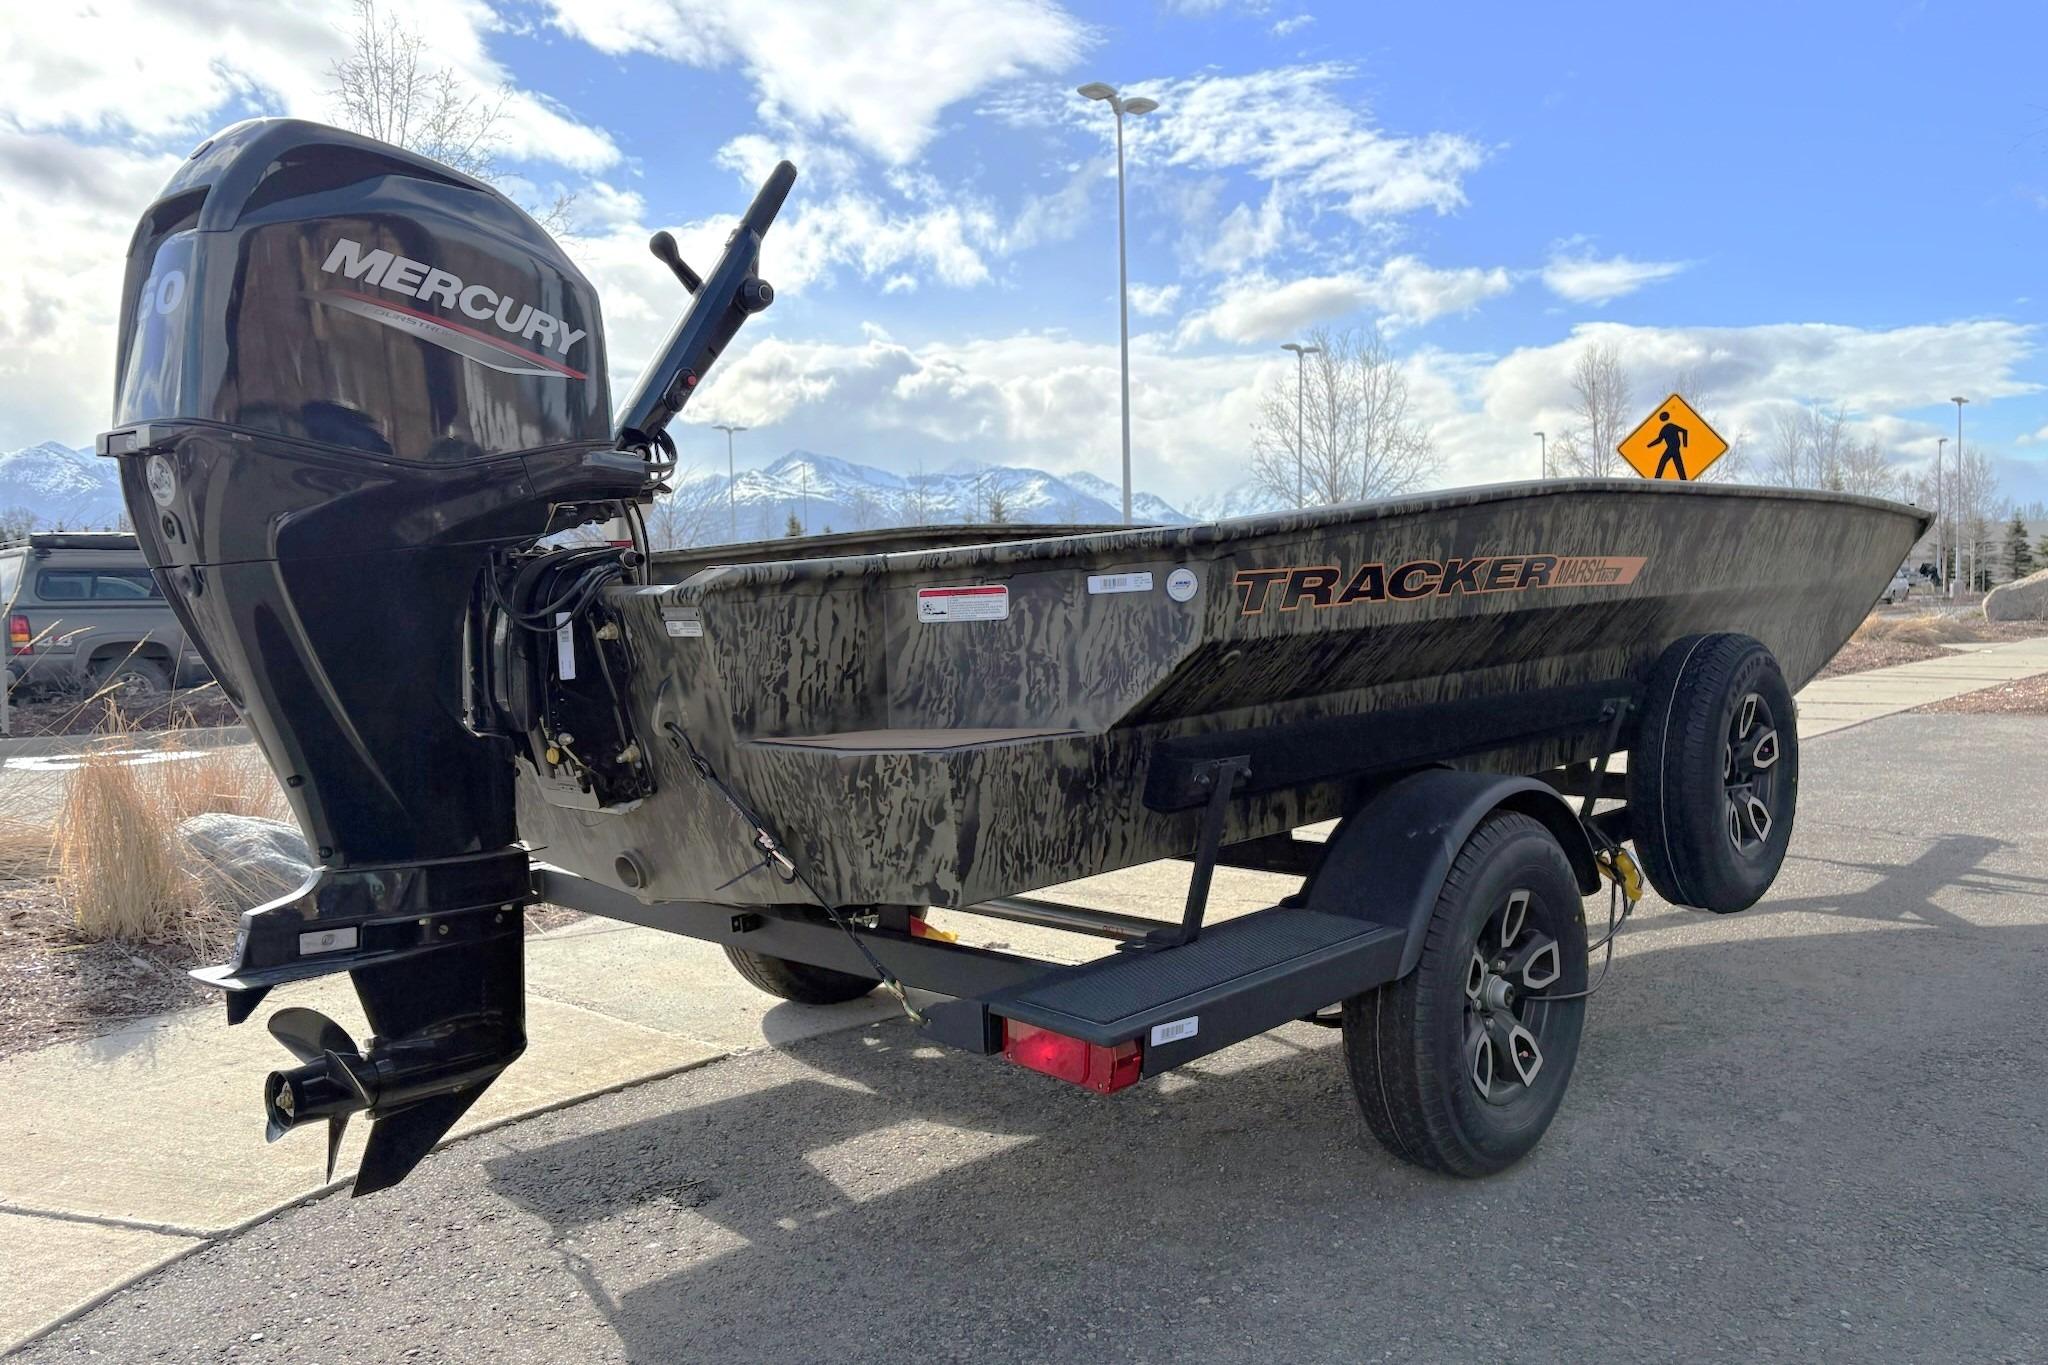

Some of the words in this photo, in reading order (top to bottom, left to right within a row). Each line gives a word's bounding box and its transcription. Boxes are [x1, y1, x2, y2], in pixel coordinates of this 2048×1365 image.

[321, 237, 587, 355] MERCURY
[362, 302, 460, 338] FOURSTRO
[1234, 554, 1558, 615] TRACKER
[1554, 559, 1606, 585] MARSH
